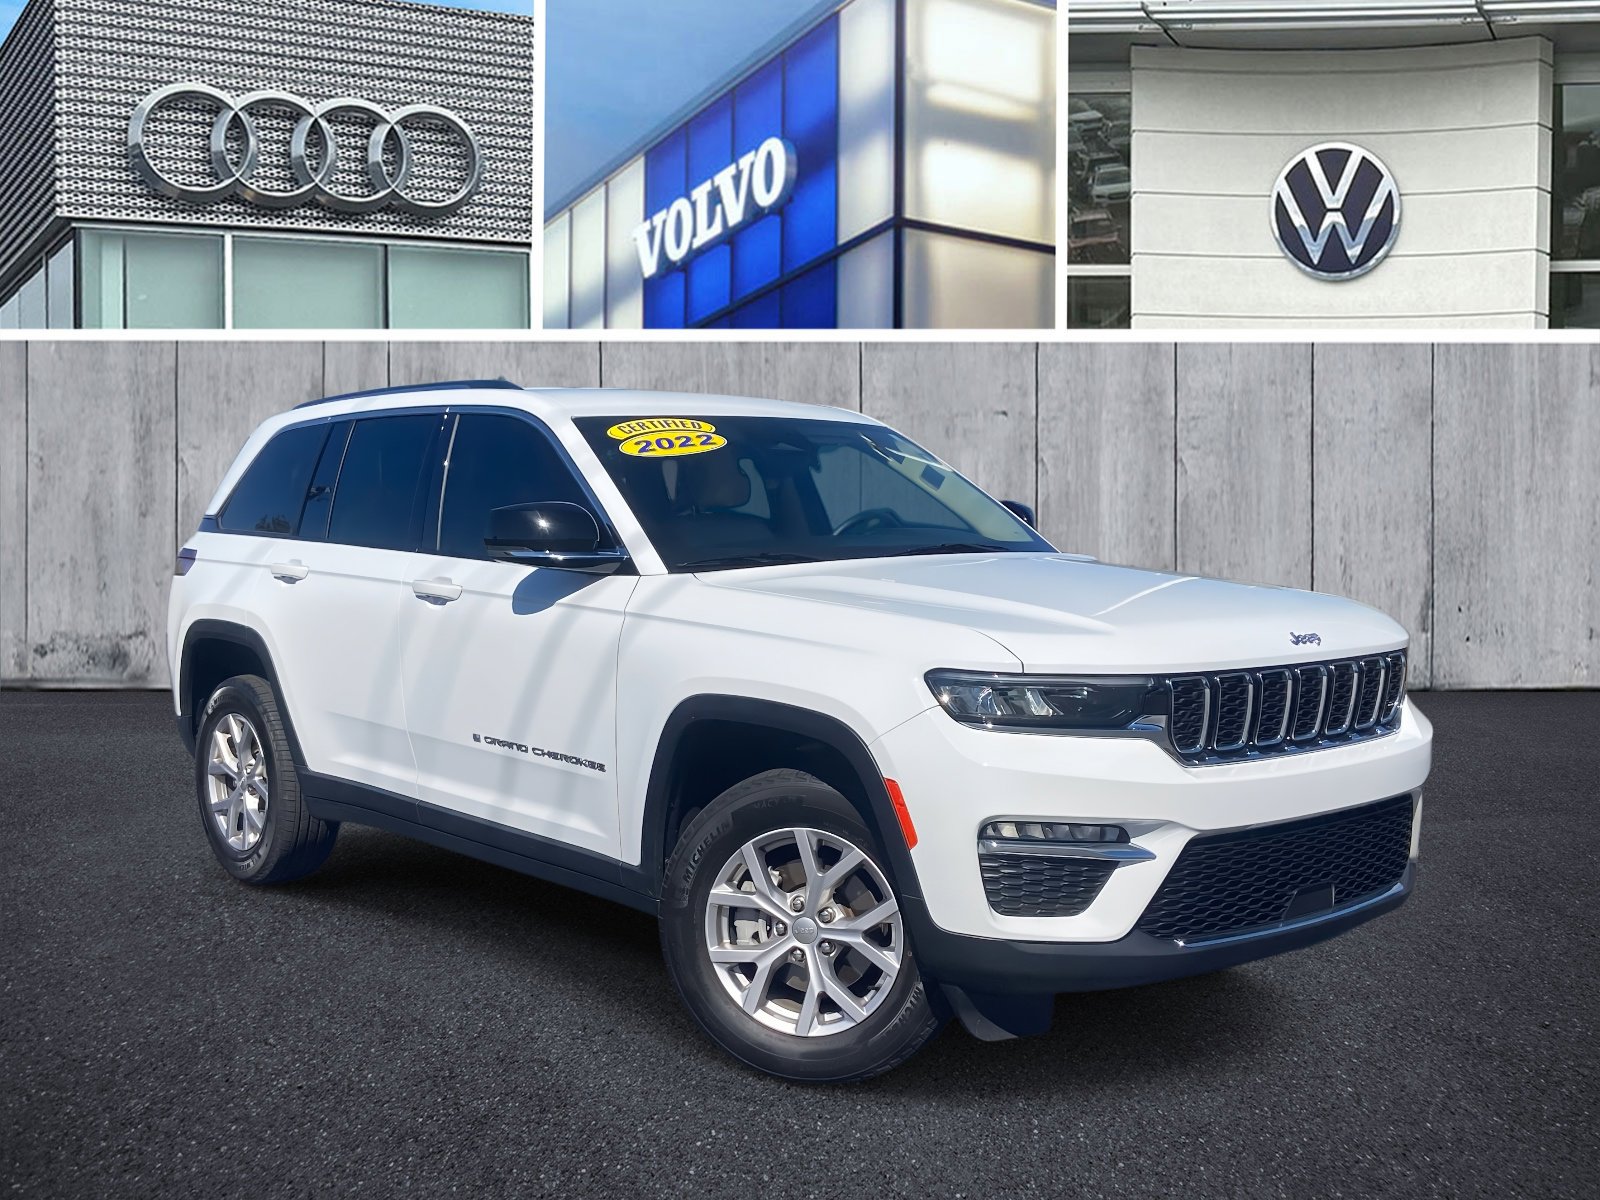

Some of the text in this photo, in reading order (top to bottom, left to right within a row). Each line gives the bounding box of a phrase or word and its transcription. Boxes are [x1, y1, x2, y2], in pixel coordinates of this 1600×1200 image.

[632, 136, 790, 279] VOLVO
[1274, 146, 1396, 268] VW
[617, 419, 703, 435] CERTIFIED
[634, 433, 717, 454] 2022
[1289, 631, 1322, 647] Jeep
[483, 735, 607, 773] GRAND CHEROKEE
[682, 820, 731, 885] MICHELIN
